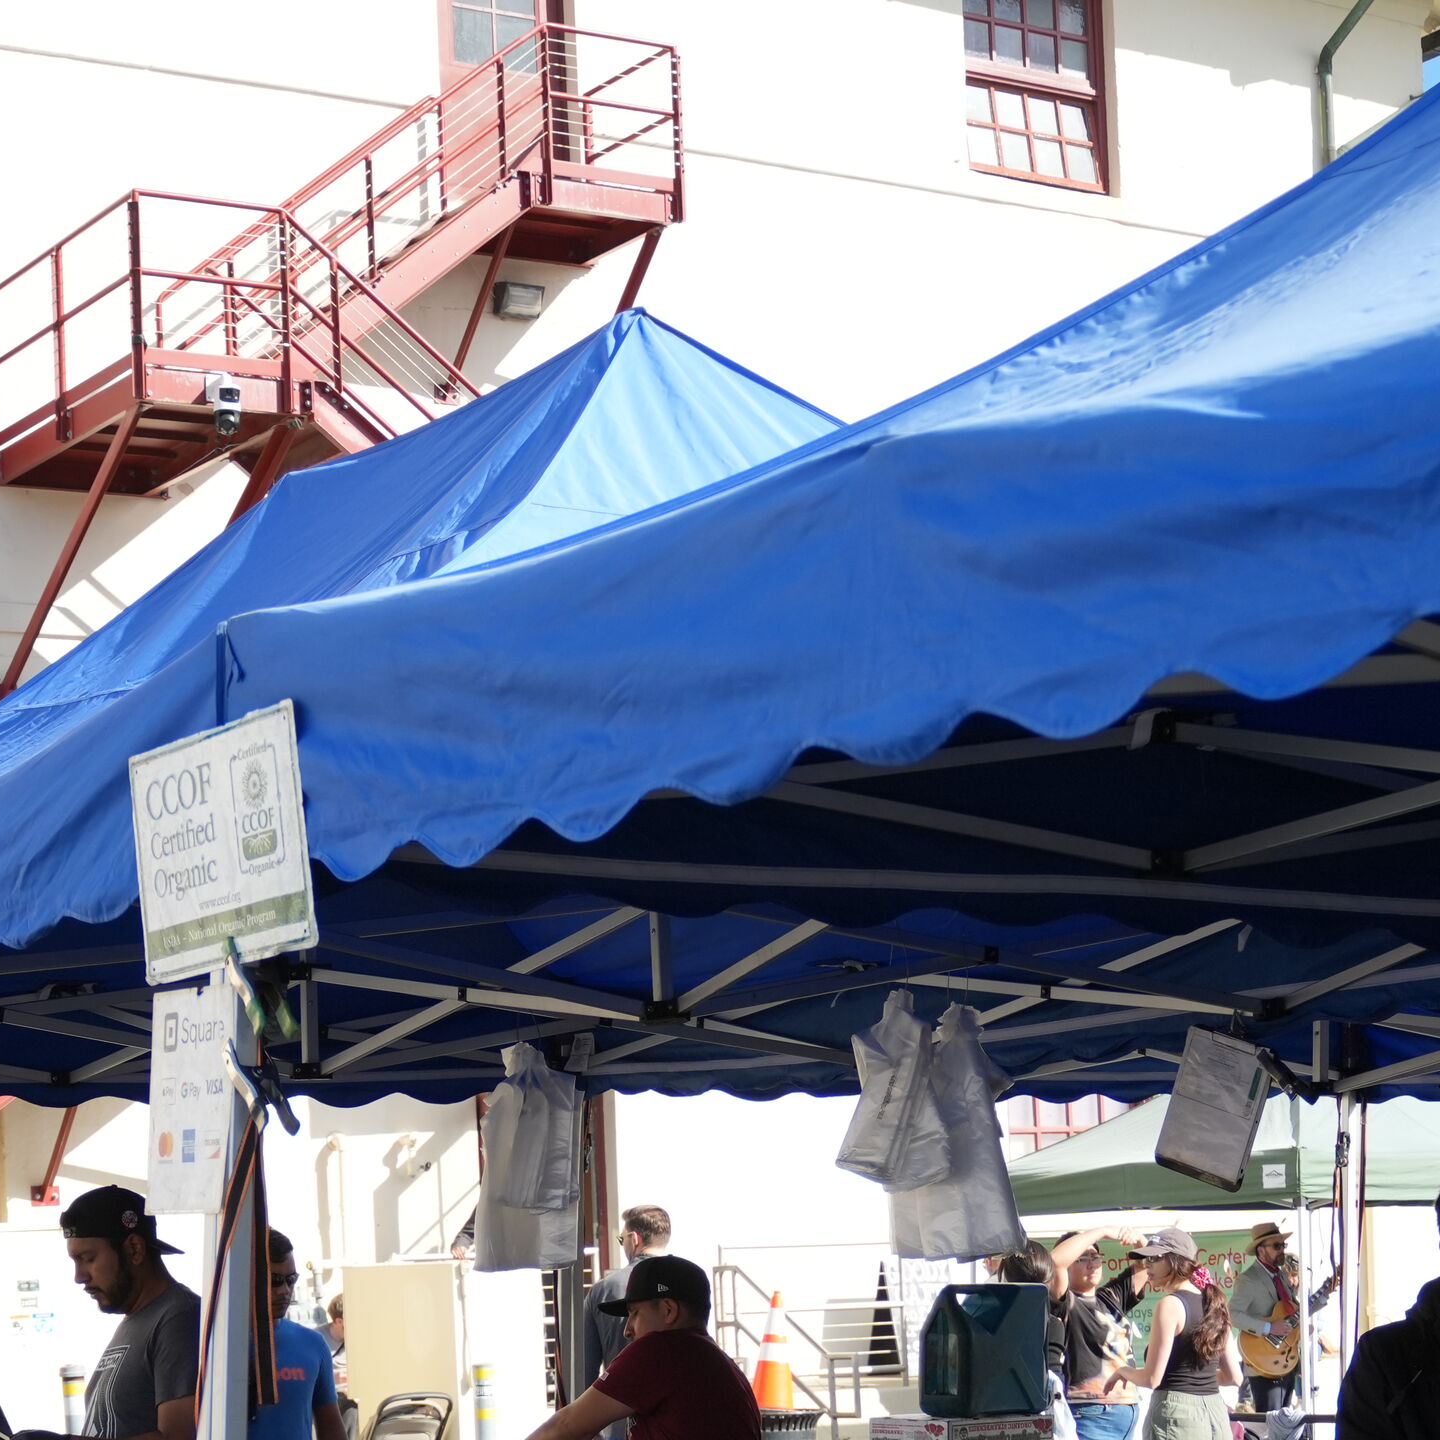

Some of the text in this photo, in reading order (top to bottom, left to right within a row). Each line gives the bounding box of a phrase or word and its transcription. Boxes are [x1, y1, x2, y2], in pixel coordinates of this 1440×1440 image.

[237, 739, 269, 760] Certified
[147, 762, 212, 820] CCOF
[242, 807, 275, 834] CCOF
[151, 813, 216, 860] Certified
[155, 856, 218, 900] Organic
[248, 858, 276, 880] Organic
[200, 891, 242, 910] www.ccof.org
[189, 922, 217, 944] National
[219, 913, 245, 938] Organic
[247, 908, 277, 930] Program
[181, 1017, 225, 1050] Square
[205, 1078, 224, 1097] VISA
[1195, 1247, 1248, 1273] Center
